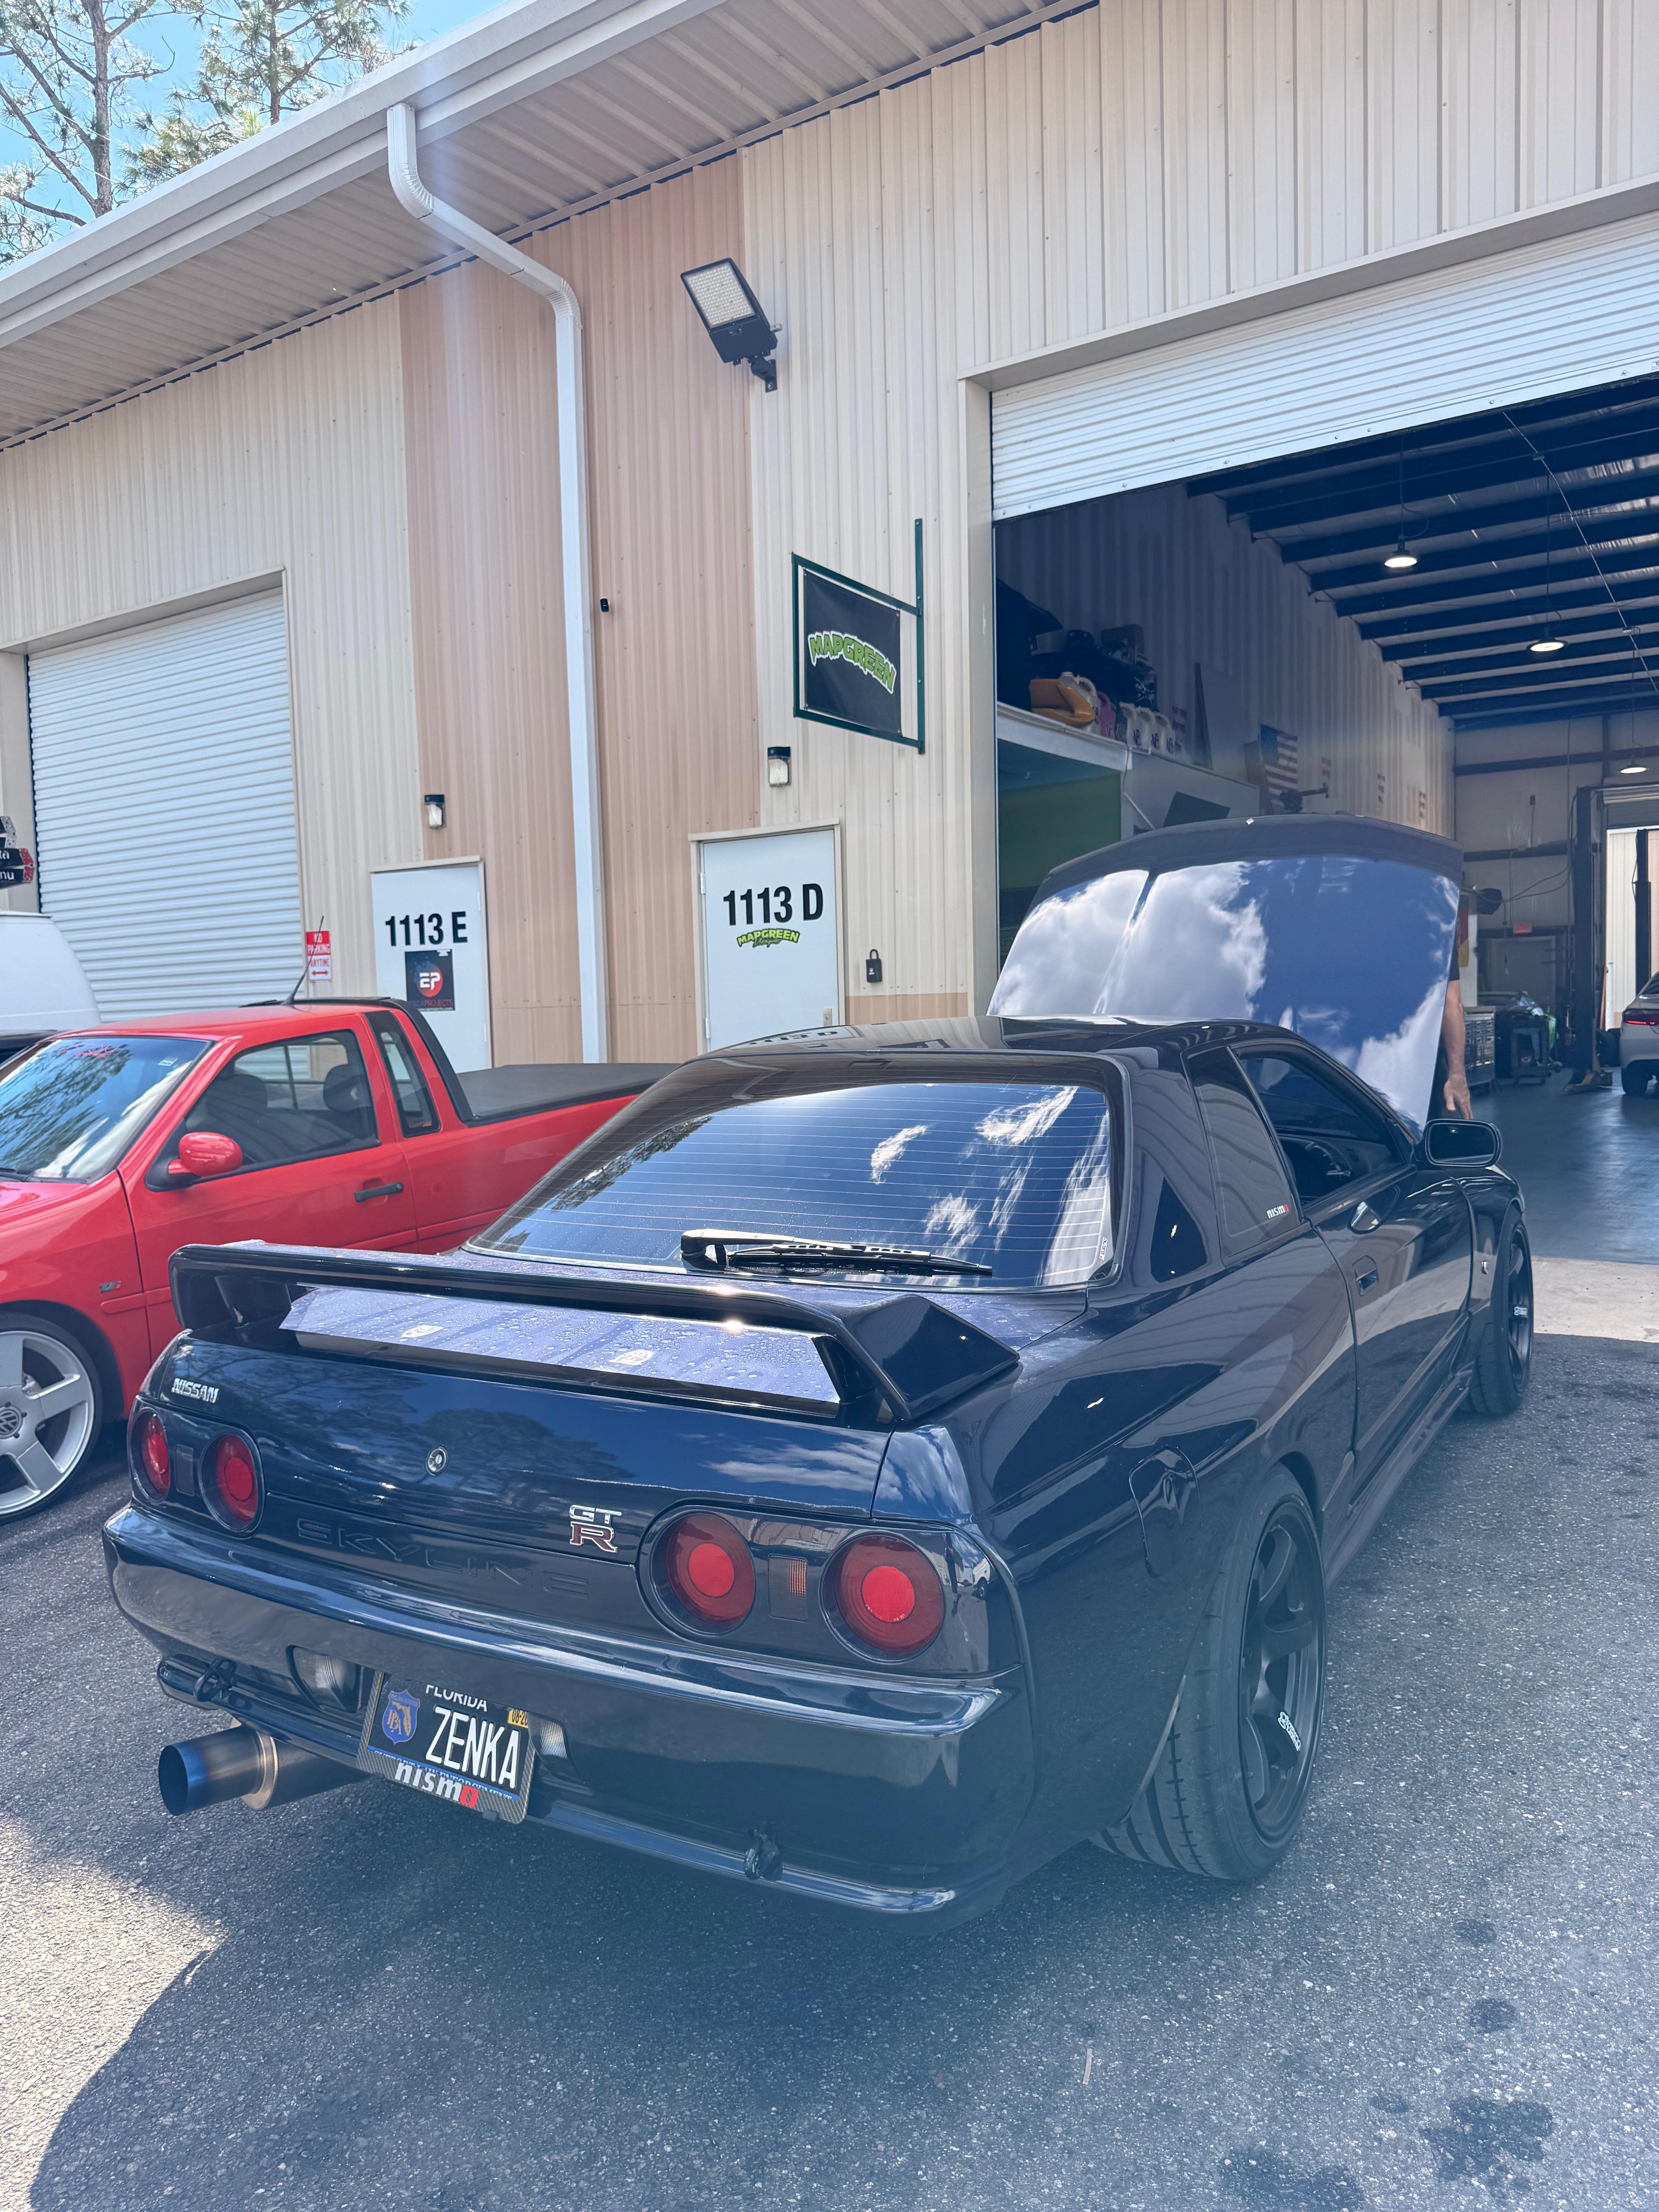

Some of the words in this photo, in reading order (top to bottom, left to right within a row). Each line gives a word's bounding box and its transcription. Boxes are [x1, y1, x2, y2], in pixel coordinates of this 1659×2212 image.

[808, 631, 896, 694] MAPGREEN
[723, 886, 792, 926] 1113
[802, 883, 823, 921] D
[315, 933, 322, 943] NO
[385, 913, 444, 947] 1113
[451, 911, 468, 944] E
[737, 928, 800, 947] MAPGREEN
[307, 944, 331, 954] PARKING
[419, 972, 440, 990] EP
[1266, 1204, 1289, 1219] nismo
[171, 1378, 219, 1404] NISSAN
[569, 1504, 623, 1524] GT
[570, 1521, 618, 1553] R
[296, 1517, 589, 1599] SKYLINE
[425, 1684, 487, 1712] FLORIDA
[426, 1706, 519, 1789] ZENKA
[394, 1762, 478, 1808] nismo
